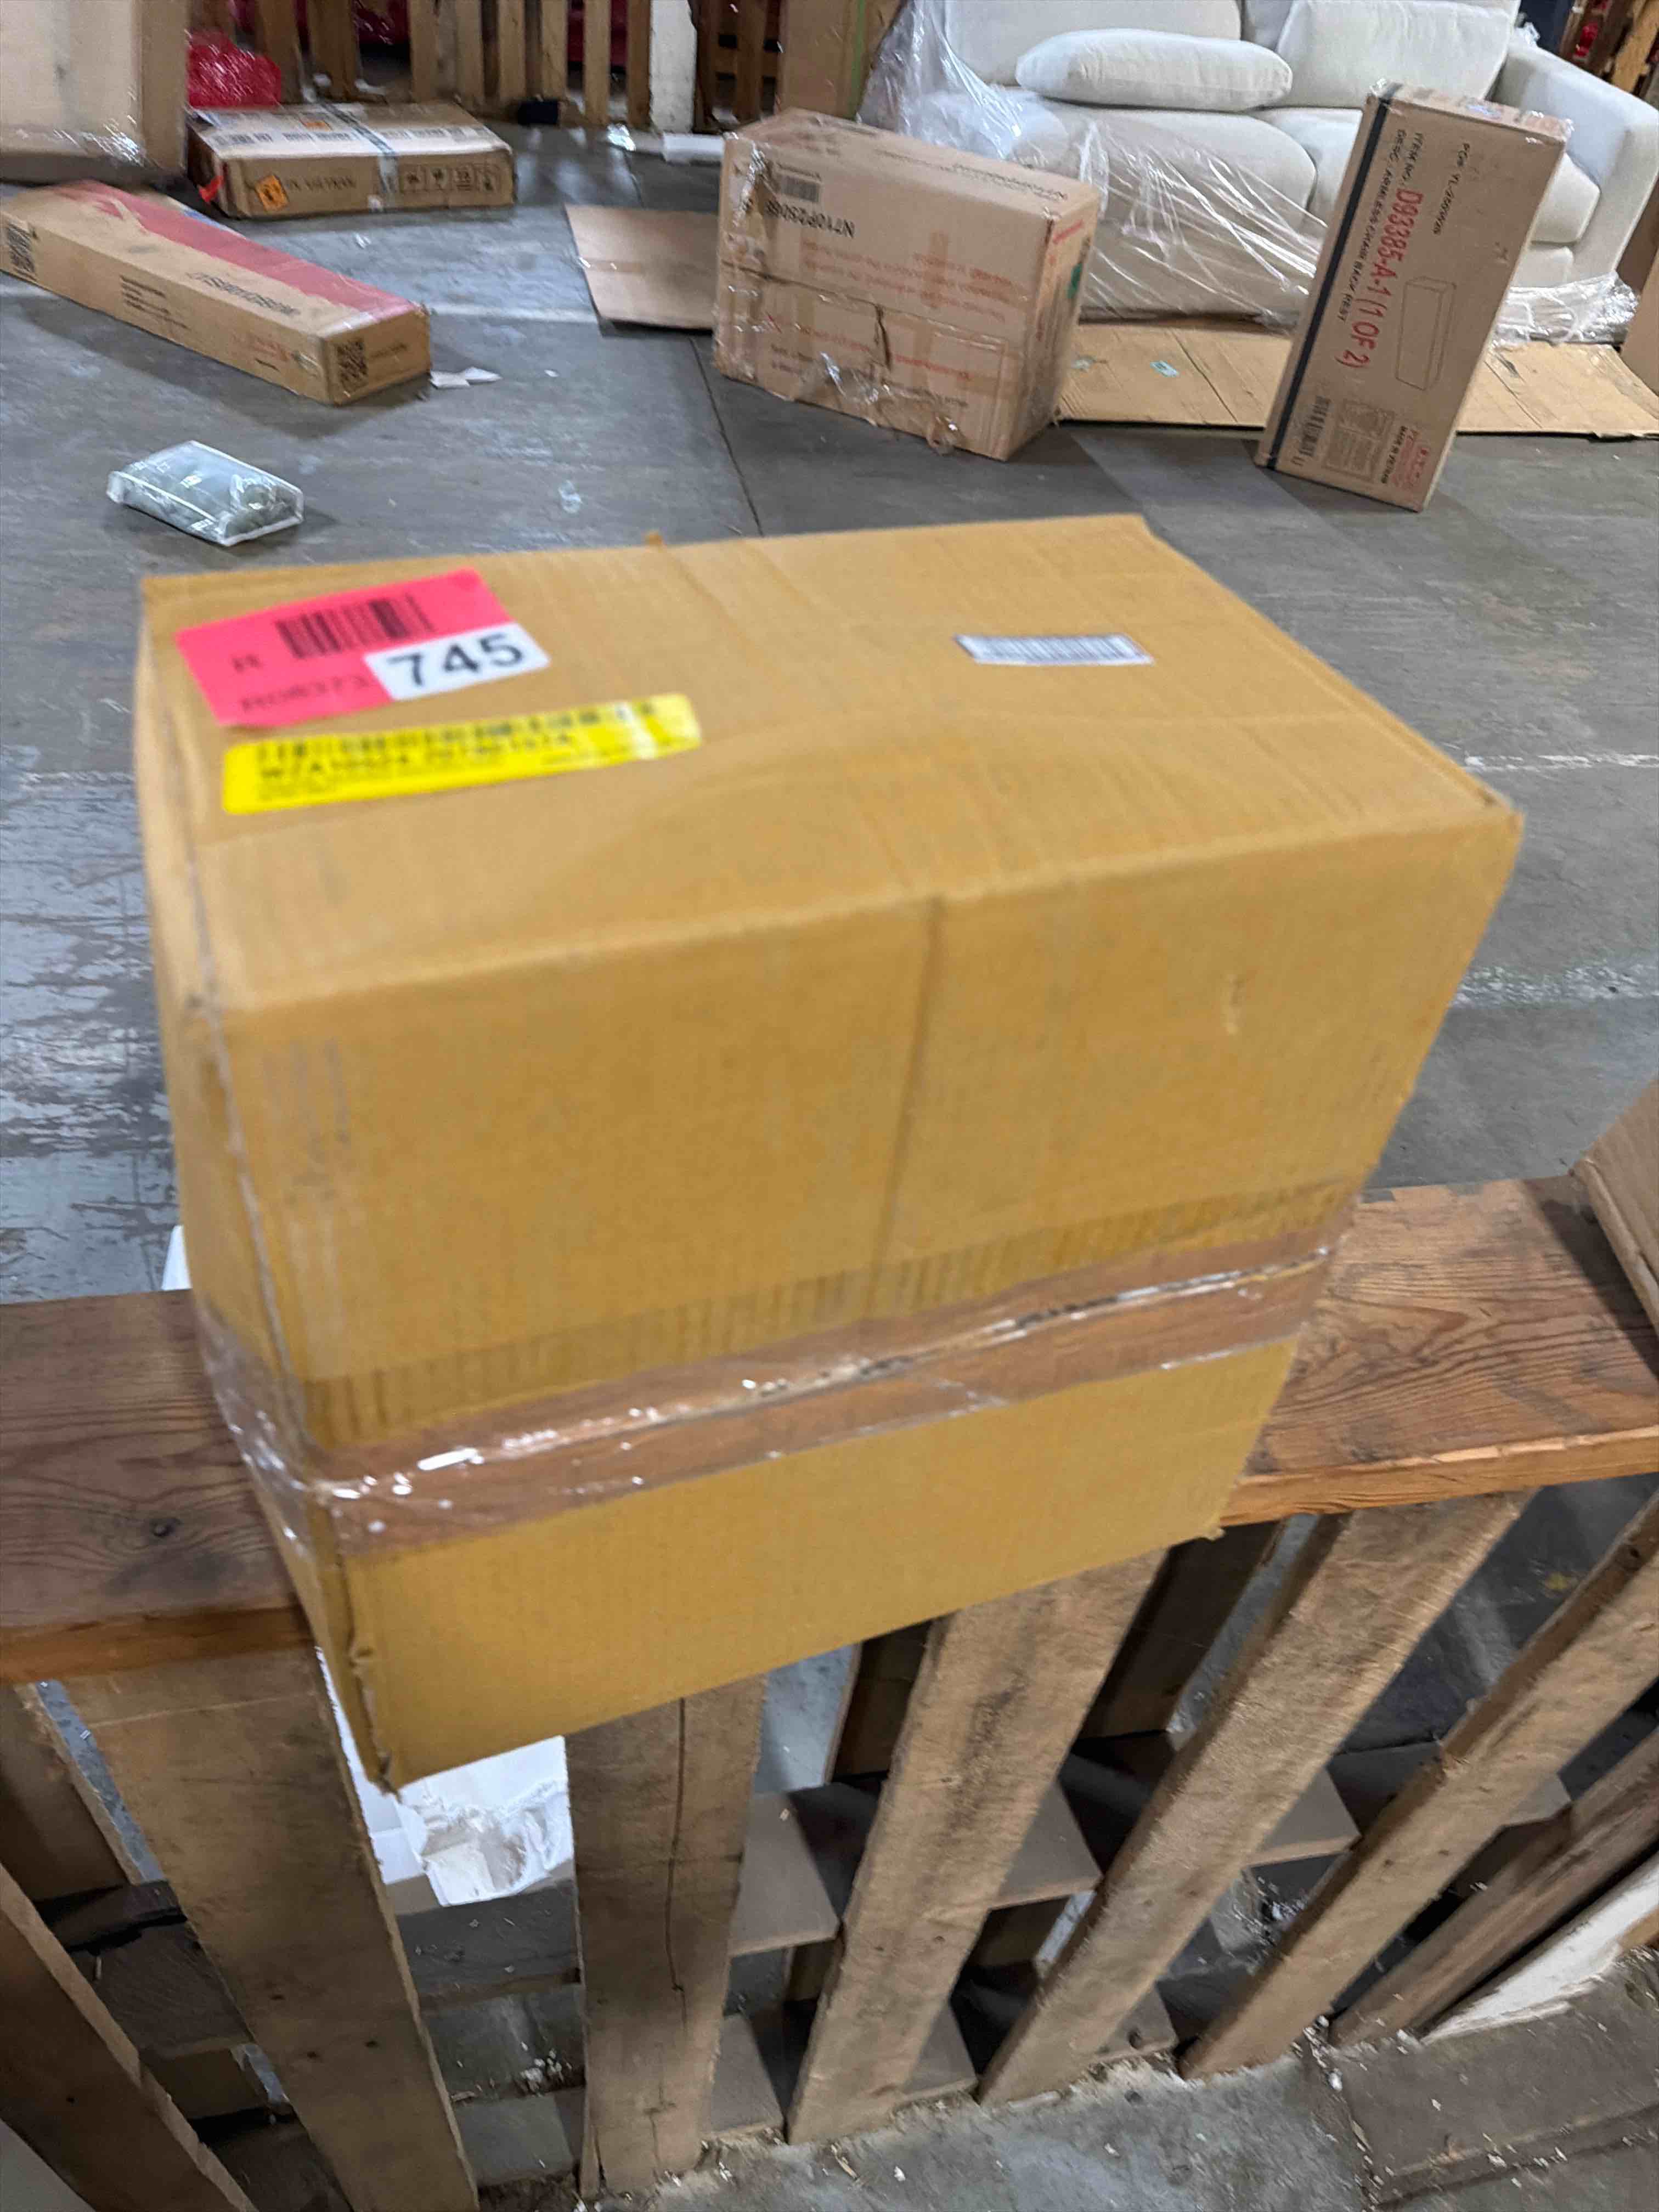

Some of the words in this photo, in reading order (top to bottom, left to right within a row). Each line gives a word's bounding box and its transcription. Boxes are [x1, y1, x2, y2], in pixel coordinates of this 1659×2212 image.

[1350, 321, 1380, 350] OF
[1334, 349, 1370, 369] 2)
[386, 633, 523, 686] 745
